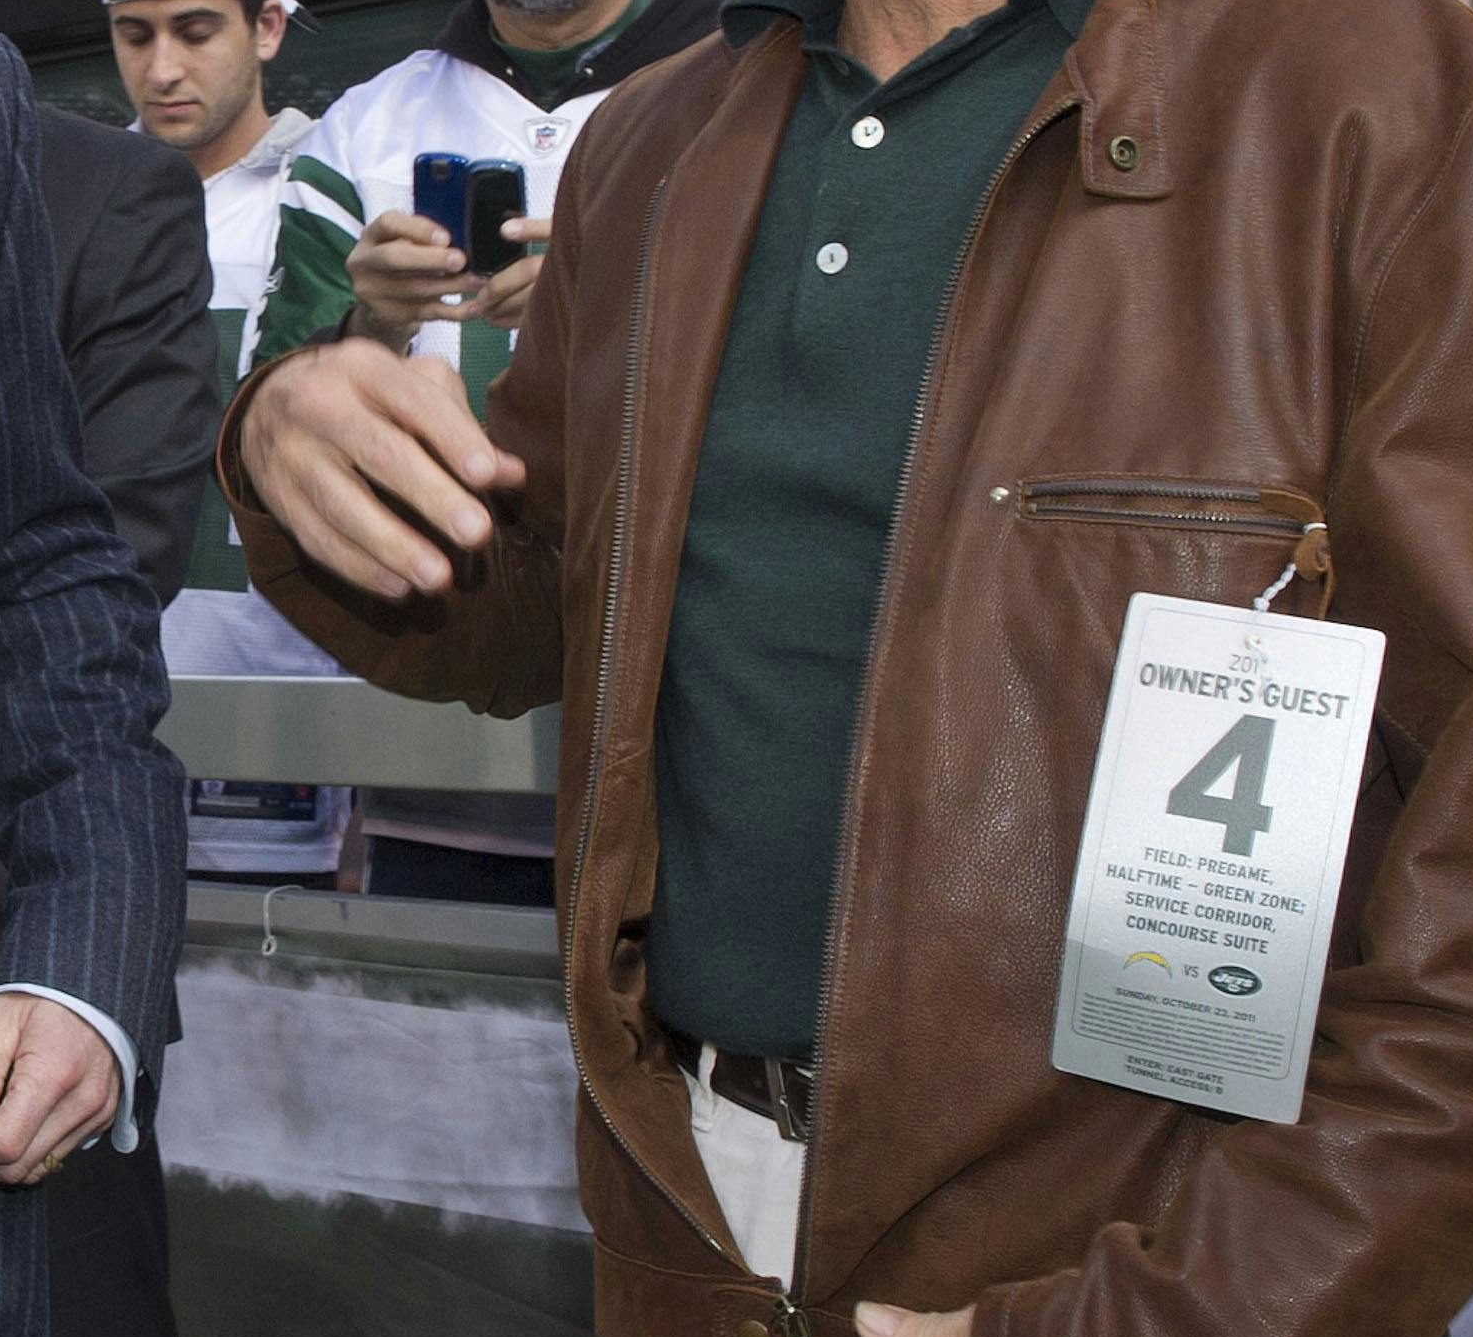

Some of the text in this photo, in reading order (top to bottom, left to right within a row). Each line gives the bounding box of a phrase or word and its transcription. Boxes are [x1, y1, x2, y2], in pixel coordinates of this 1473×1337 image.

[1140, 663, 1350, 719] OWNER'S GUEST
[1166, 713, 1277, 857] 4
[1106, 863, 1183, 890] HALFTIME
[1204, 882, 1256, 904] GREEN
[1144, 847, 1274, 886] FIELD: PREGAME,
[1125, 891, 1277, 933] SERVICE CORRIDOR,
[1126, 915, 1269, 954] CONCOURSE SUITE
[1183, 964, 1200, 979] VS
